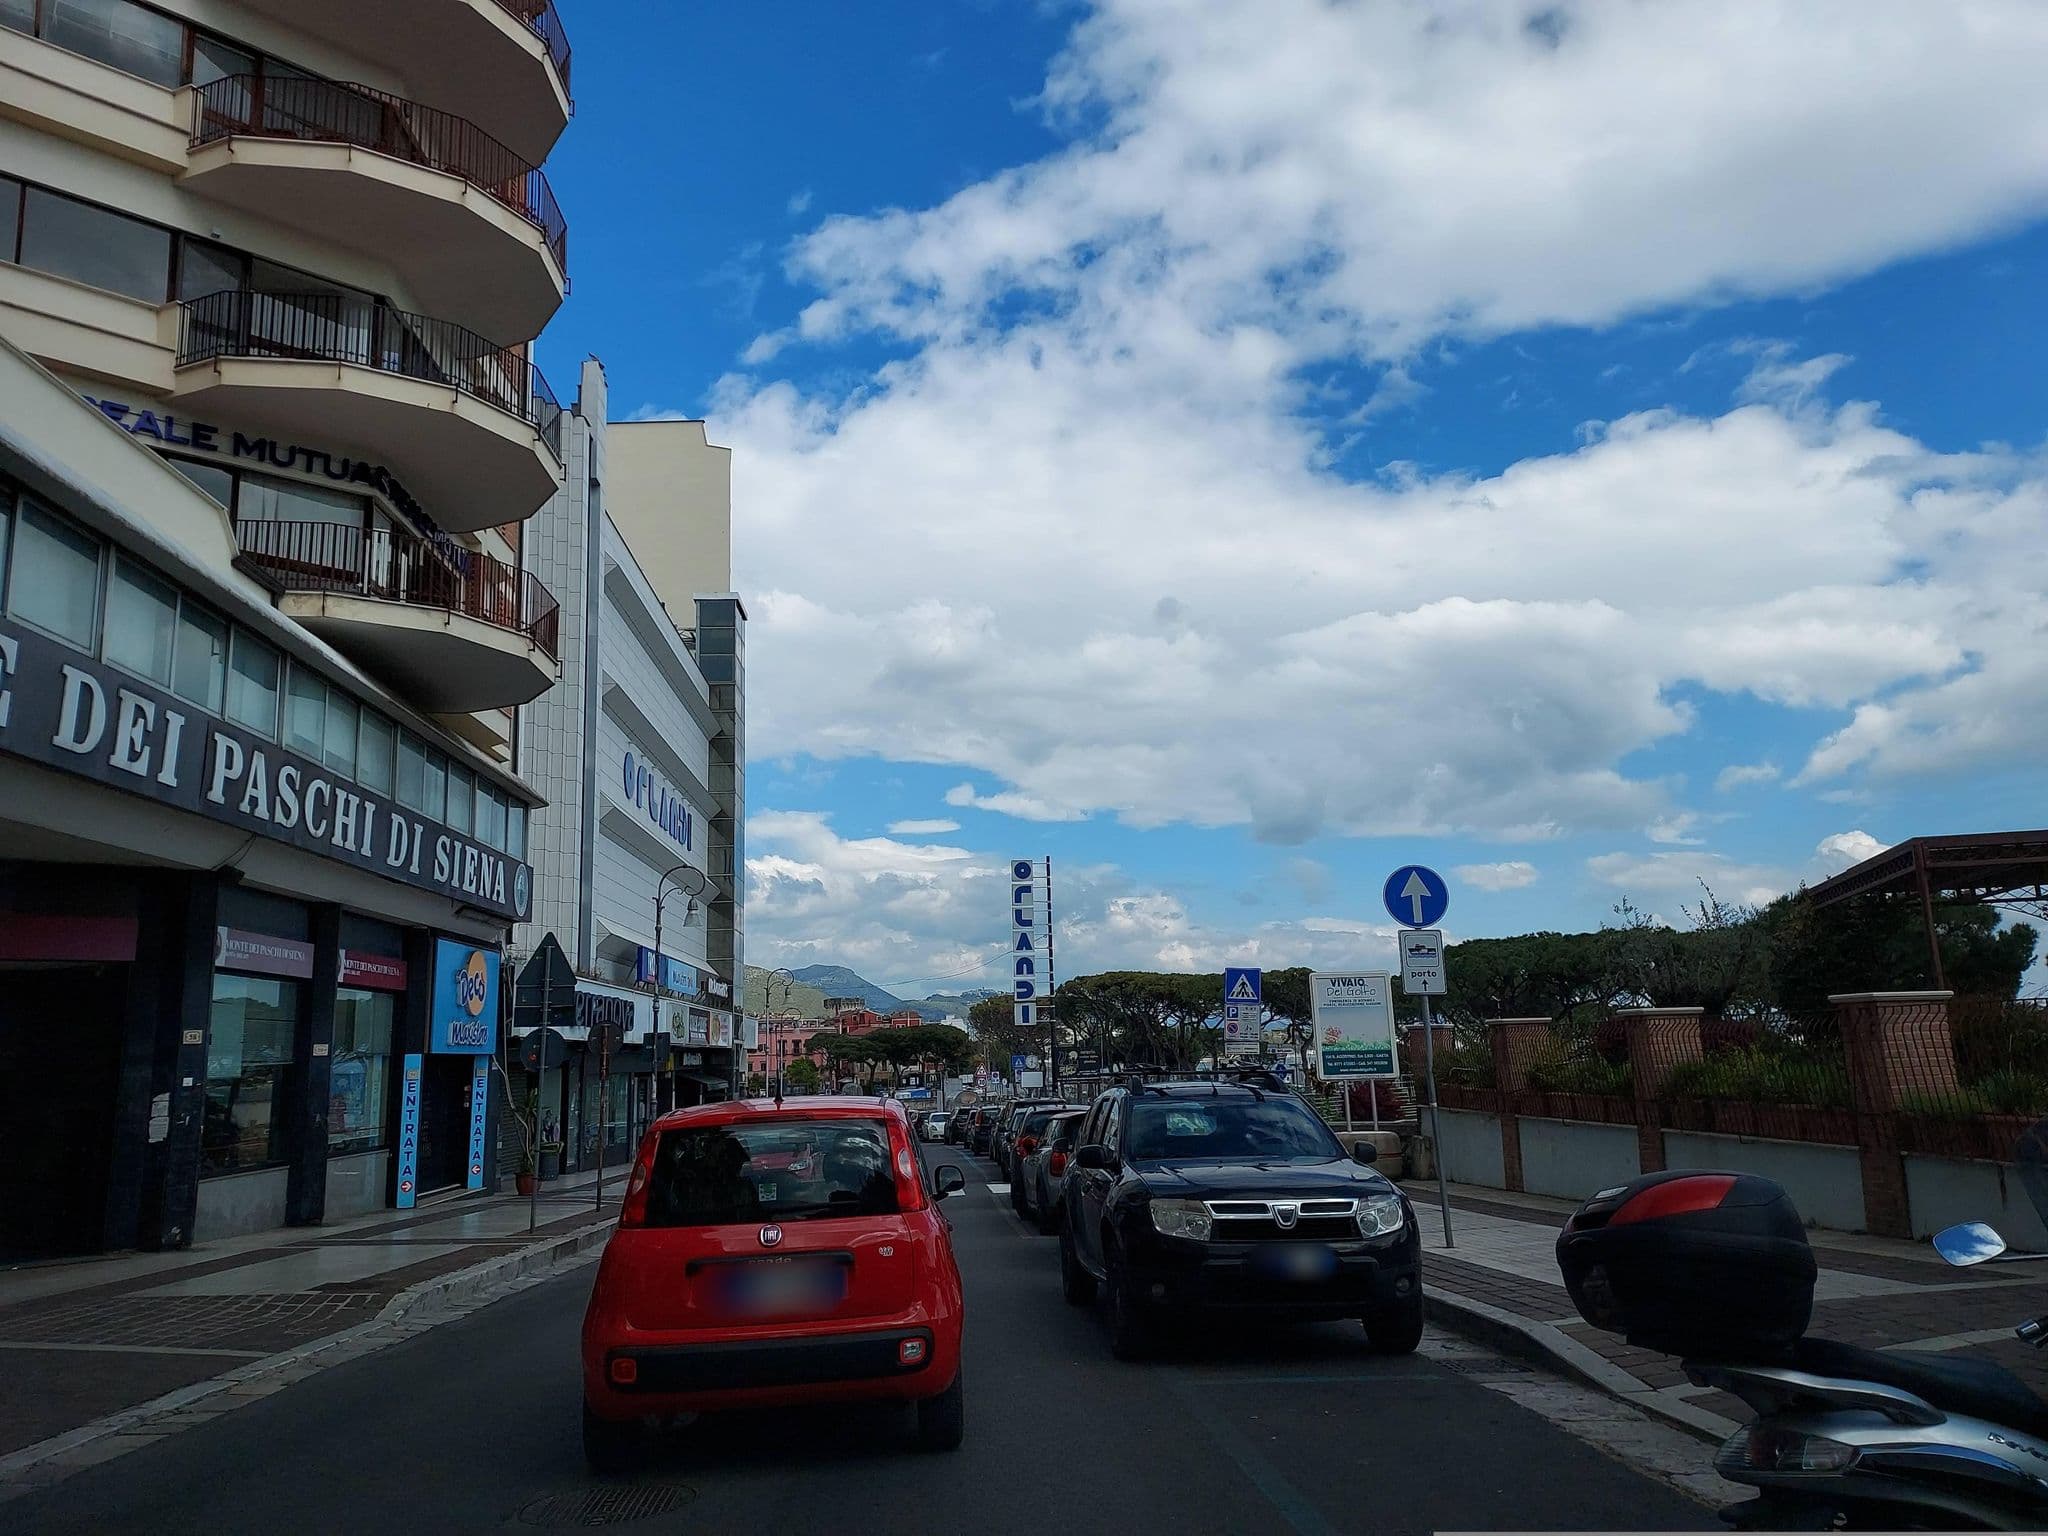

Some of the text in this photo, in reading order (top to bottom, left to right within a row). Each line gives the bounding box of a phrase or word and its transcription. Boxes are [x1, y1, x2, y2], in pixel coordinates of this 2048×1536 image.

[82, 394, 219, 448] EALE
[52, 664, 185, 788] DEI
[207, 731, 376, 858] PASCHI
[386, 812, 425, 875] DI
[433, 834, 507, 906] SIENA
[623, 751, 692, 851] ORLANDI
[1013, 861, 1035, 1023] ORLANDI
[1411, 970, 1437, 978] porto
[1327, 984, 1377, 996] Del Golfo
[1330, 978, 1365, 987] VIVAIO
[402, 1082, 417, 1176] ENTRATA
[472, 1079, 483, 1160] ENTRATA
[764, 1230, 779, 1241] FIAT
